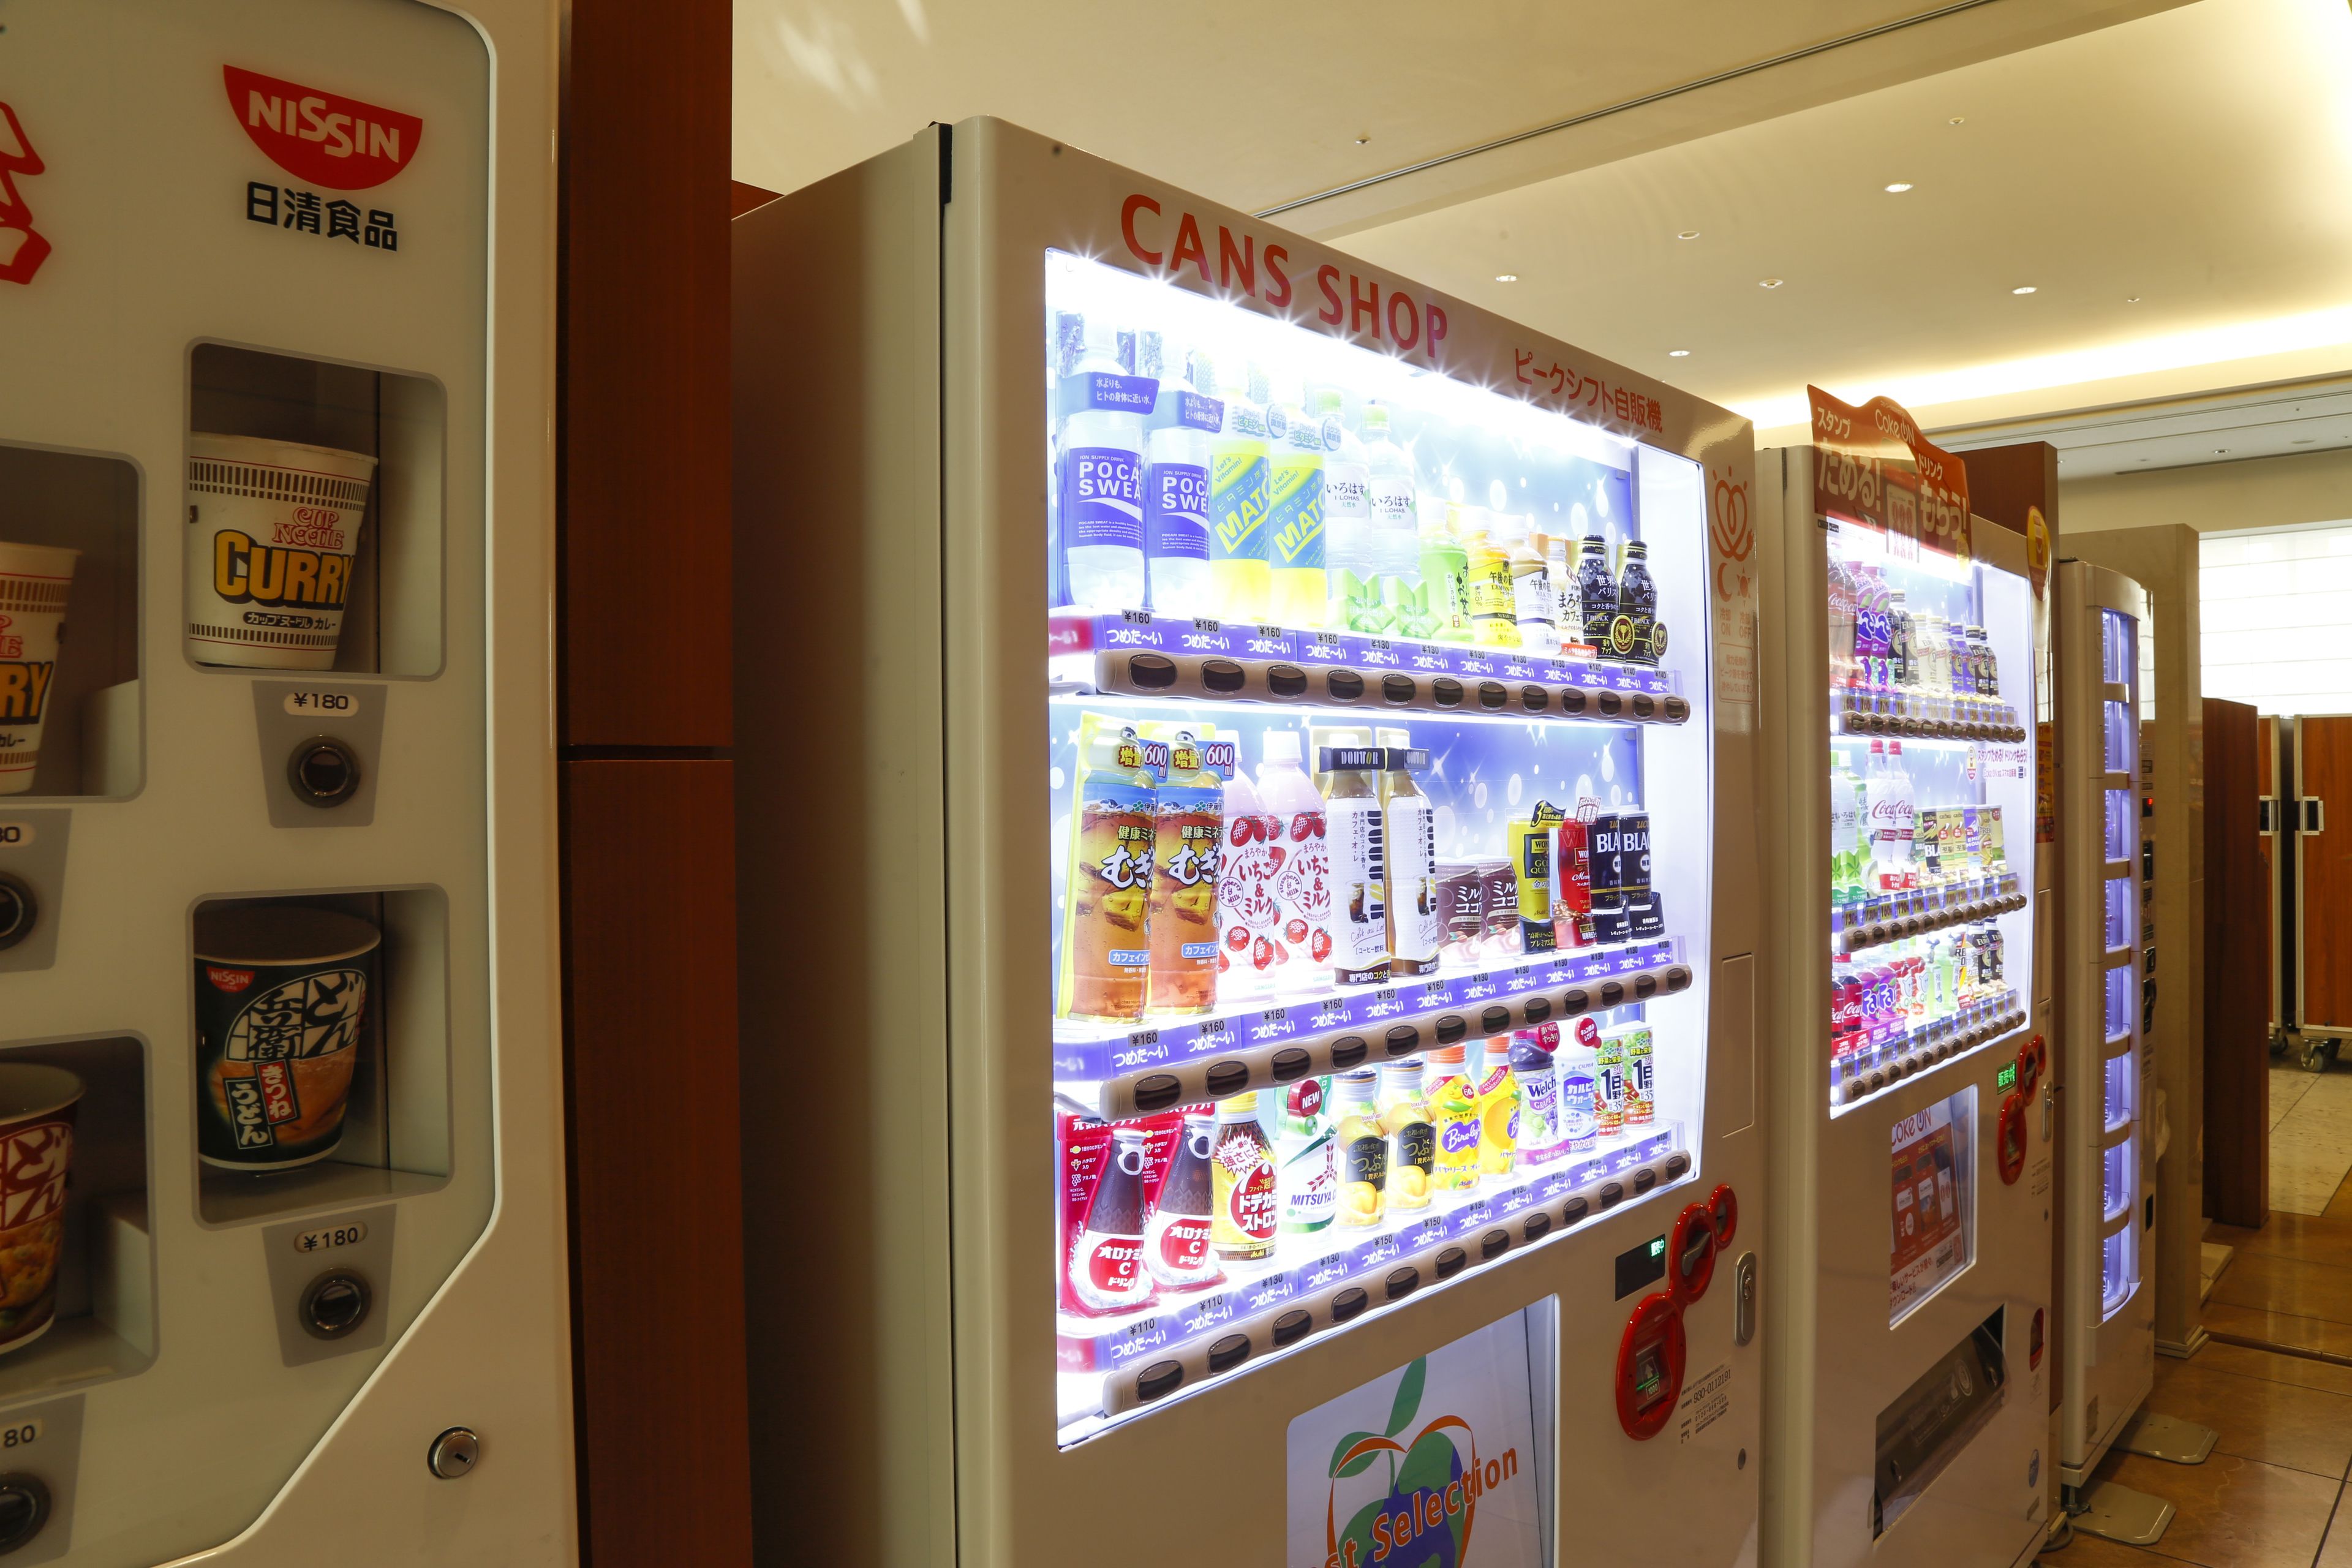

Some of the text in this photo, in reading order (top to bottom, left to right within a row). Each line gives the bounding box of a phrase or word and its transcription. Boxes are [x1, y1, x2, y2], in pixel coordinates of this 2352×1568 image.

[248, 90, 399, 163] NISSIN
[246, 181, 398, 252] 日清食品
[1121, 194, 1447, 358] CANS SHOP
[1515, 348, 1663, 433] ピークシフト自販機
[1096, 391, 1152, 405] ヒトの身体に近い水。
[1817, 406, 1851, 439] スタンプ
[1875, 409, 1899, 440] Coke
[1899, 421, 1916, 447] ON
[1215, 458, 1243, 483] Vitamin!
[1216, 456, 1232, 472] Let's
[1918, 453, 1943, 481] ドリンク
[1079, 461, 1142, 483] POCA
[1274, 470, 1289, 485] Let's
[1818, 436, 1882, 513] ためる!
[1273, 470, 1299, 496] Vitamin!
[1326, 482, 1365, 496] いろはす
[1371, 495, 1411, 508] いろはす
[1920, 480, 1968, 540] もらう!
[293, 507, 339, 529] CUP
[314, 617, 336, 630] カレー
[1125, 611, 1150, 625] ¥160
[1196, 620, 1218, 632] ¥160
[1259, 627, 1280, 638] ¥160
[1721, 622, 1731, 636] ON
[1739, 626, 1752, 639] OFF
[1318, 633, 1337, 644] ¥160
[1371, 639, 1390, 650] ¥130
[1422, 645, 1439, 655] ¥130
[1469, 649, 1485, 659] ¥130
[1512, 654, 1527, 664] ¥130
[1551, 660, 1566, 668] ¥130
[1589, 663, 1602, 672] ¥140
[1623, 667, 1635, 676] ¥140
[295, 693, 349, 710] ¥180
[1119, 747, 1143, 768] 増量
[1144, 744, 1169, 766] 600
[1174, 748, 1201, 770] 増量
[1205, 744, 1234, 766] 600
[1341, 751, 1378, 765] DOUTOR
[1158, 764, 1167, 778] ml
[1224, 764, 1233, 777] ml
[1303, 843, 1327, 854] まろやか
[1596, 832, 1621, 853] BLA
[1245, 847, 1267, 859] まろやか
[1254, 883, 1264, 898] &
[1313, 877, 1324, 891] &
[1227, 894, 1240, 905] Milk
[1287, 888, 1299, 897] Milk
[1245, 896, 1273, 917] ミルク
[1554, 959, 1568, 968] ¥130
[1591, 952, 1604, 962] ¥130
[210, 968, 250, 985] NISSIN
[1515, 965, 1529, 974] ¥130
[1472, 972, 1489, 983] ¥130
[1427, 981, 1444, 992] ¥160
[1377, 989, 1395, 1001] ¥160
[1322, 998, 1343, 1011] ¥160
[1264, 1009, 1285, 1022] ¥160
[1201, 1020, 1224, 1034] ¥160
[1133, 1033, 1158, 1047] ¥160
[1997, 1067, 2015, 1087] 販売中
[261, 1065, 293, 1119] きつね
[1302, 1090, 1320, 1110] NEW
[1534, 1097, 1552, 1109] GRAPE
[231, 1082, 269, 1147] うどん
[1291, 1194, 1331, 1206] MITSUYA
[1469, 1200, 1486, 1212] ¥130
[1424, 1216, 1441, 1229] ¥150
[303, 1227, 358, 1251] ¥180
[1374, 1234, 1393, 1247] ¥150
[1188, 1242, 1201, 1254] C
[1178, 1254, 1204, 1265] ドリンク
[1320, 1253, 1340, 1267] ¥130
[1118, 1262, 1131, 1276] C
[1107, 1276, 1135, 1290] ドリンク
[1262, 1273, 1283, 1288] ¥130
[1199, 1294, 1223, 1312] ¥110
[1130, 1319, 1155, 1336] ¥110
[1693, 1369, 1732, 1404] 930-0112191
[1372, 1447, 1518, 1562] Selection
